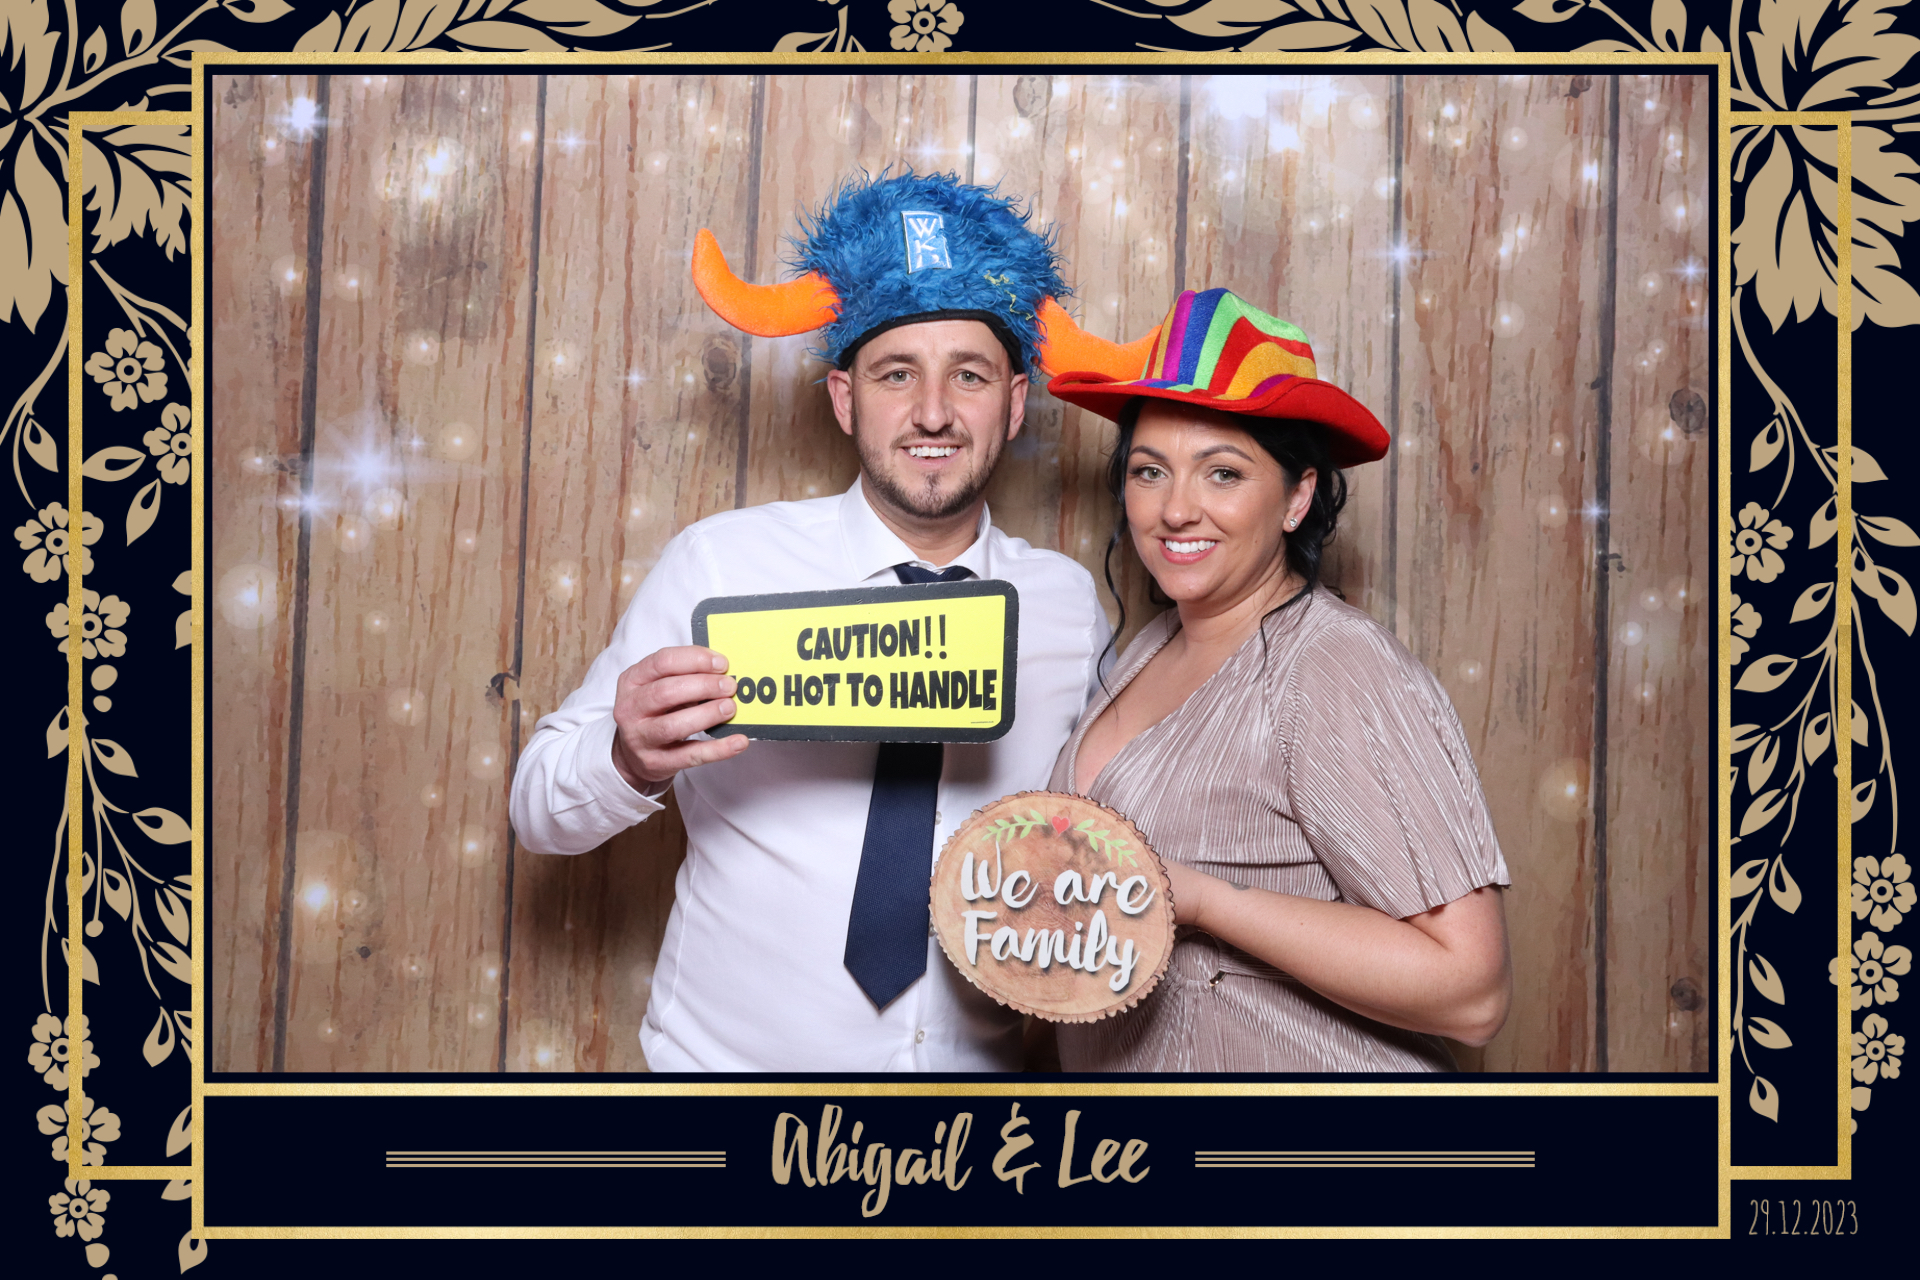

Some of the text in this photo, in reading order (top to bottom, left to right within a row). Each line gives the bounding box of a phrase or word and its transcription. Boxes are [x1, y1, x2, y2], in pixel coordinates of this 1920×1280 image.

[796, 614, 947, 661] CAUTION!!
[730, 669, 997, 711] OO HOT TO HANDLE
[960, 840, 1157, 915] We are
[961, 909, 1141, 992] Family
